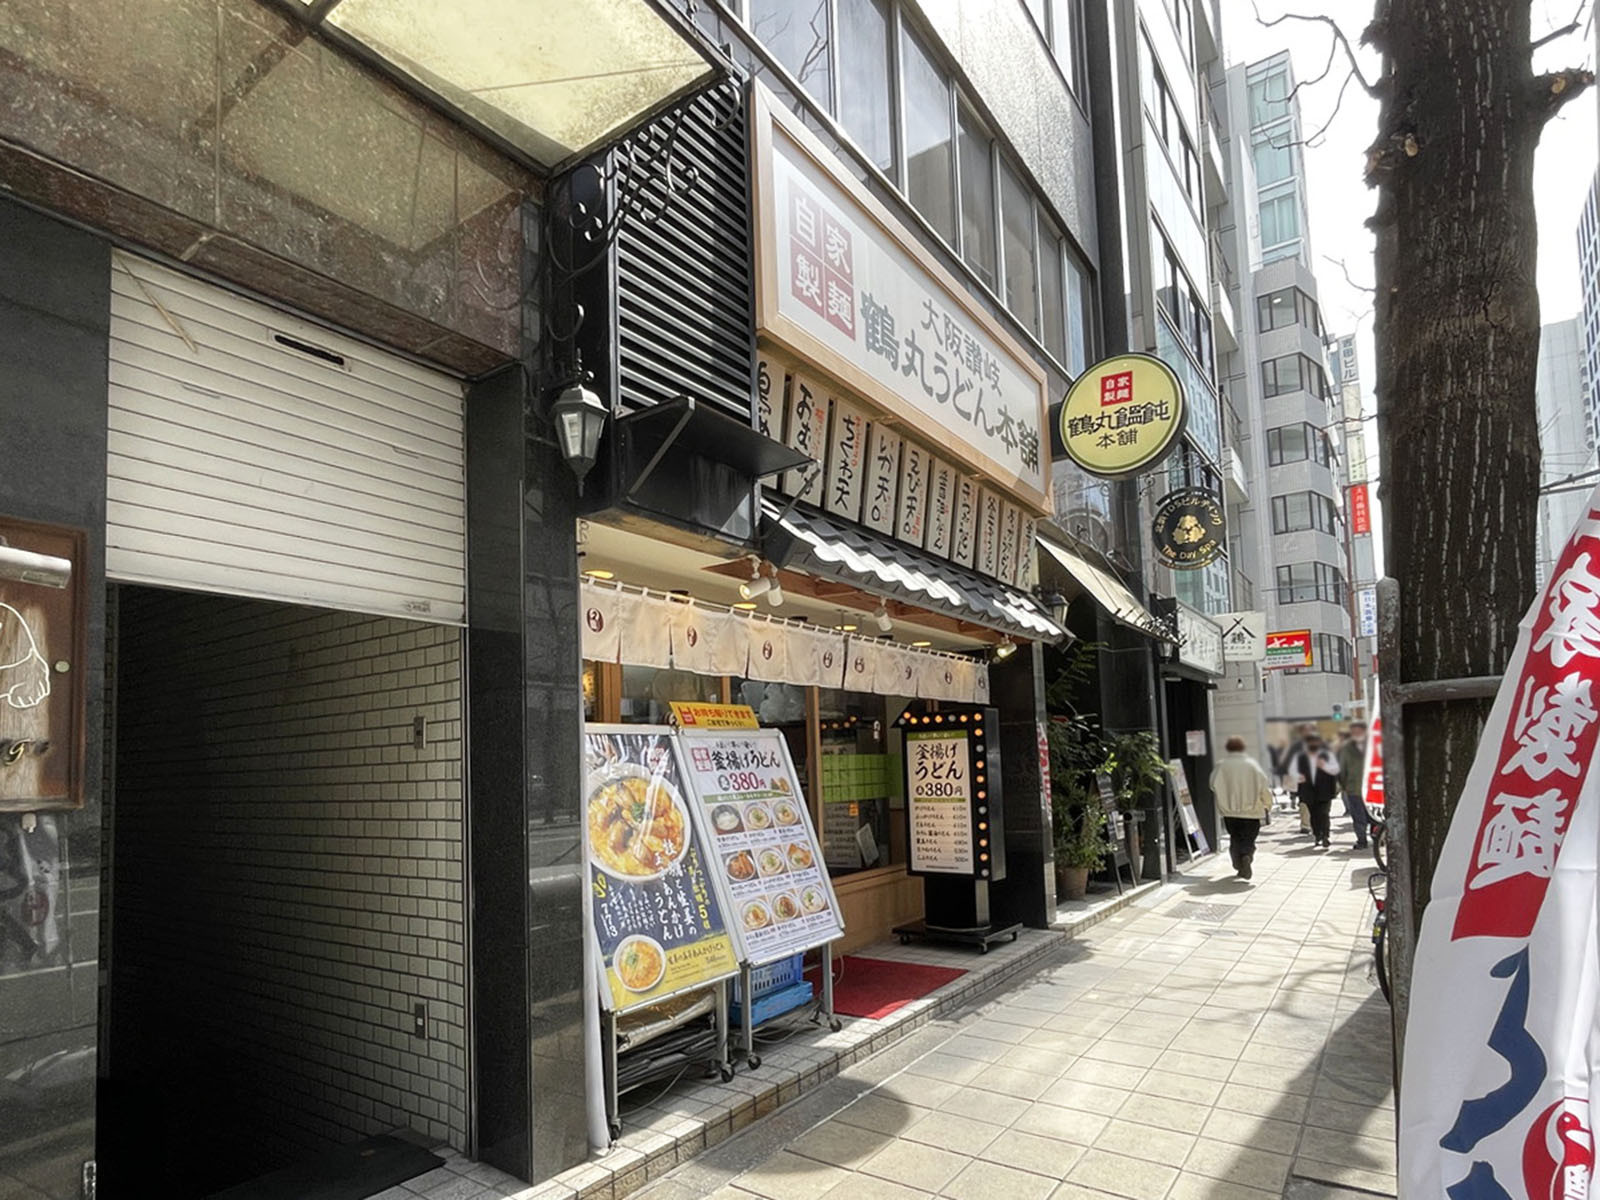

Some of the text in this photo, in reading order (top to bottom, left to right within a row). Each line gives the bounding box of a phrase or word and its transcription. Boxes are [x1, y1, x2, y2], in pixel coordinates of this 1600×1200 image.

[796, 198, 850, 273] 自家
[1096, 428, 1138, 449] 本舗
[711, 750, 780, 771] 釜揚げうどん
[915, 743, 958, 761] 釜揚げ
[914, 760, 964, 782] うどん
